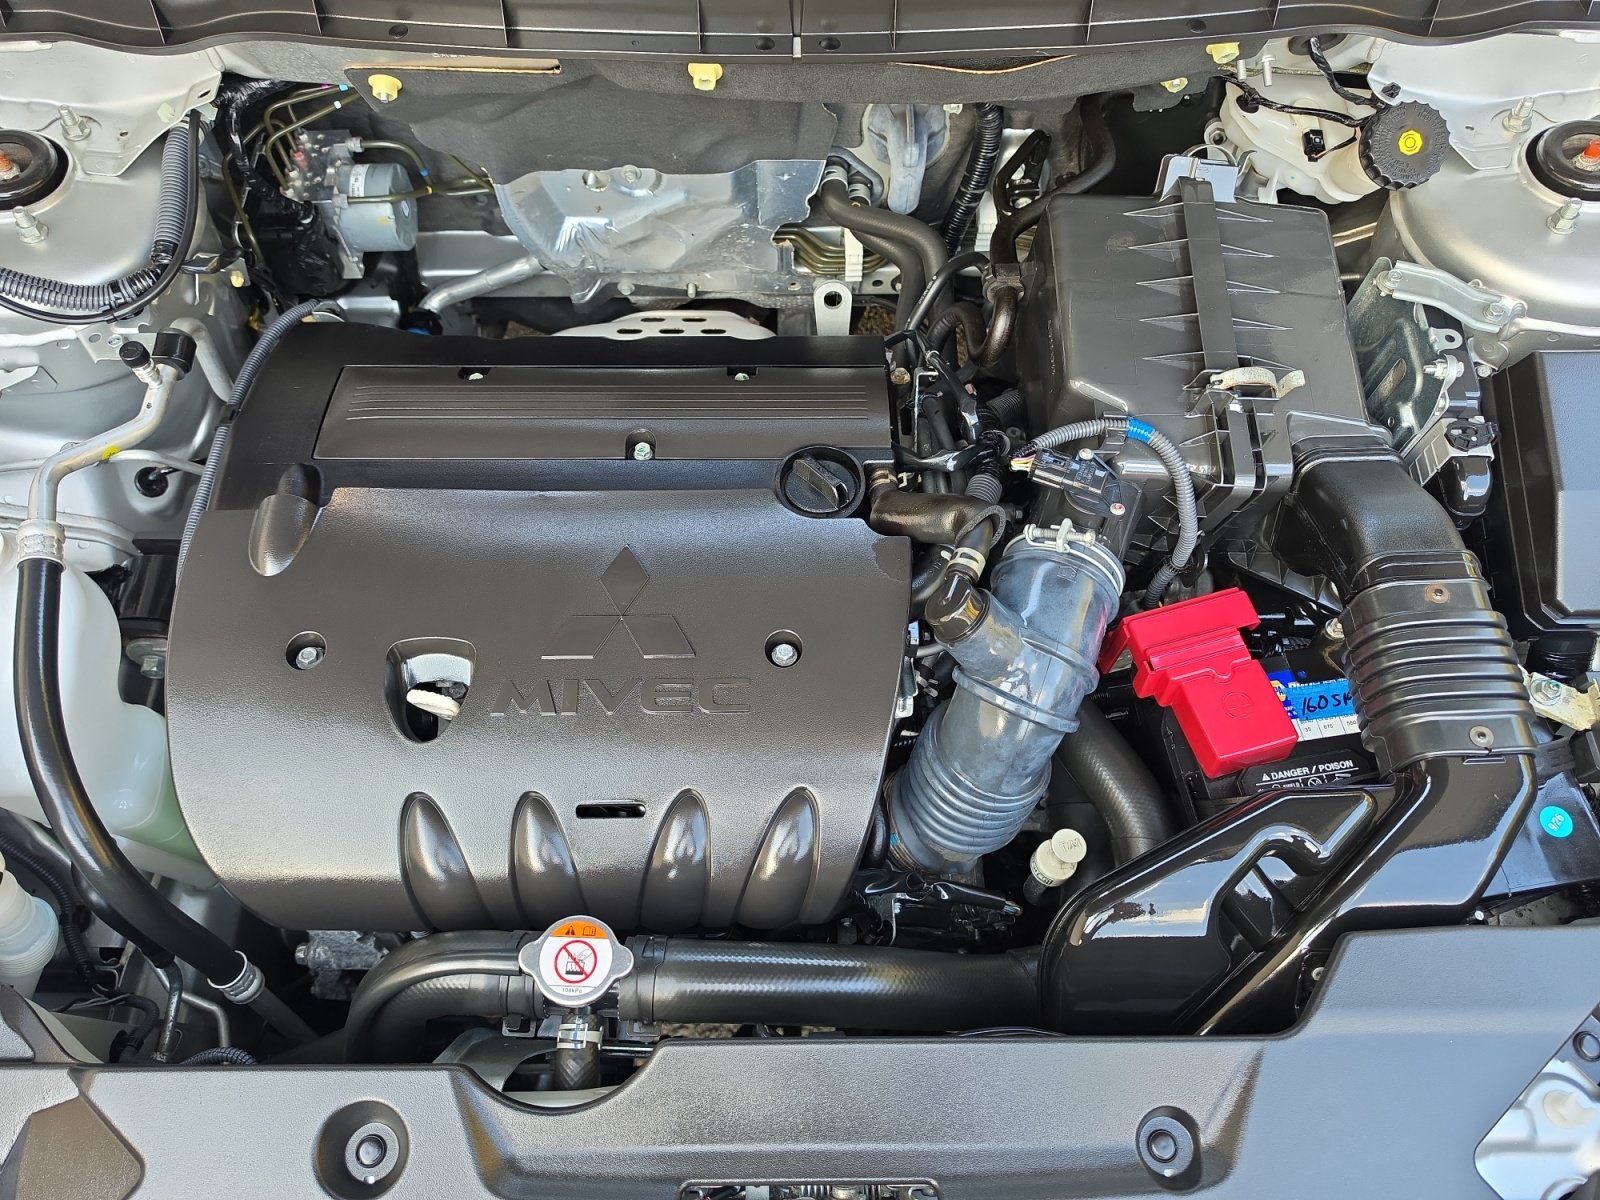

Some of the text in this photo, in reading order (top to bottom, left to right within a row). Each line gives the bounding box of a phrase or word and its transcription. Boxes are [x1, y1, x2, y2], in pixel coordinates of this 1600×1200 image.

[489, 677, 750, 716] MIVEC
[1271, 760, 1354, 780] DANGER / POISON
[1548, 813, 1565, 831] 9/26
